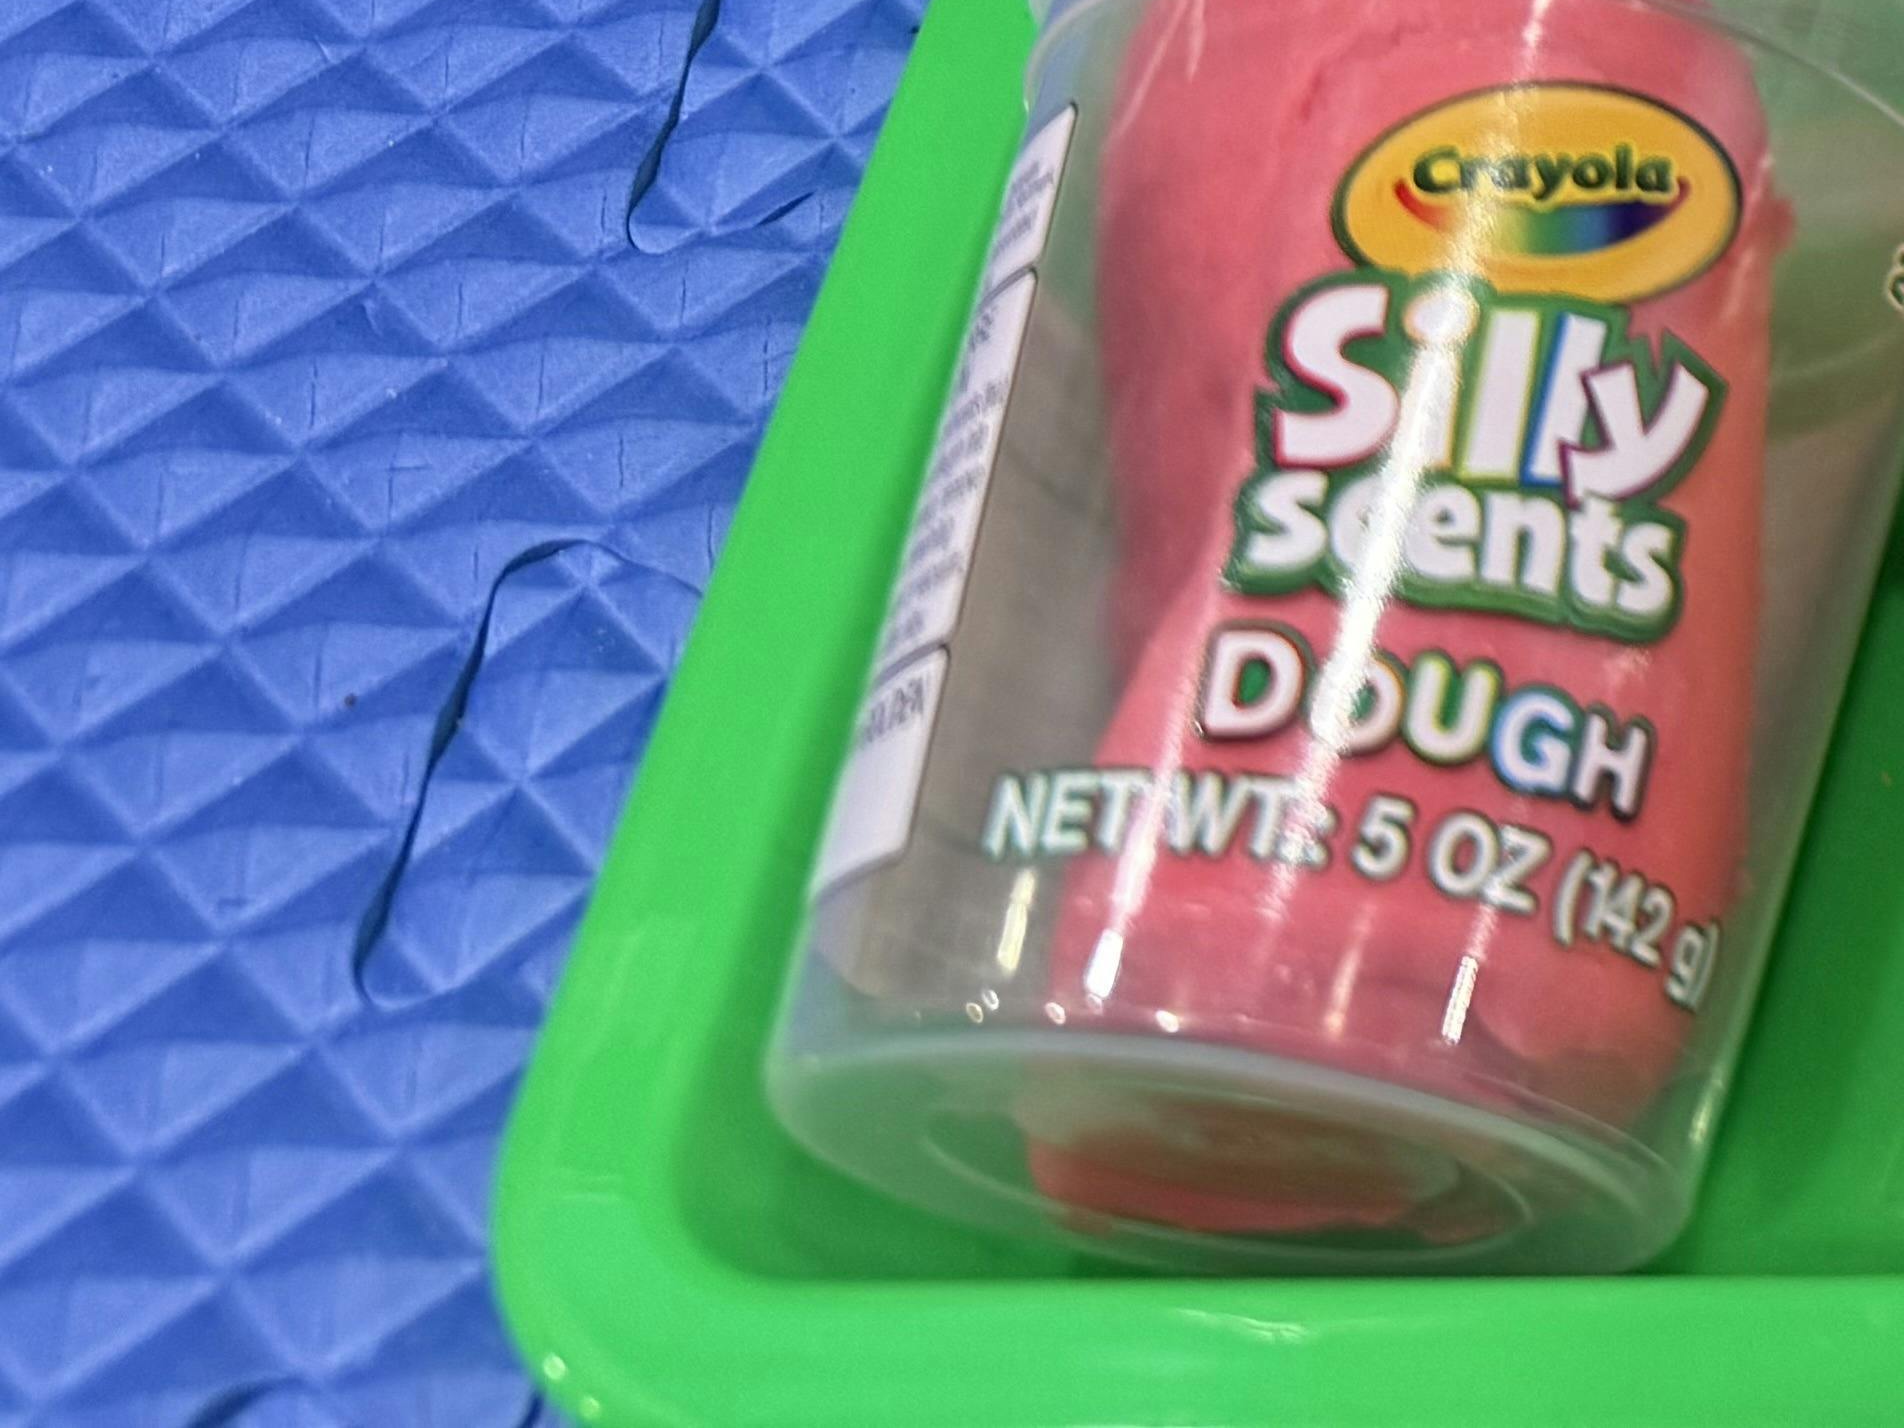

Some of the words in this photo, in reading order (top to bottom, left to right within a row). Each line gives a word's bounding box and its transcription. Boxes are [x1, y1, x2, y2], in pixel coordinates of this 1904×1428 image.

[1412, 141, 1677, 201] Crayola
[1272, 282, 1709, 509] Silly
[1242, 466, 1678, 618] scents
[1202, 626, 1655, 819] DOUGH
[981, 766, 1152, 856] NET
[1350, 792, 1416, 880] 5
[1428, 812, 1552, 914] OZ
[1553, 848, 1676, 968] (142
[1664, 919, 1721, 1012] g)
